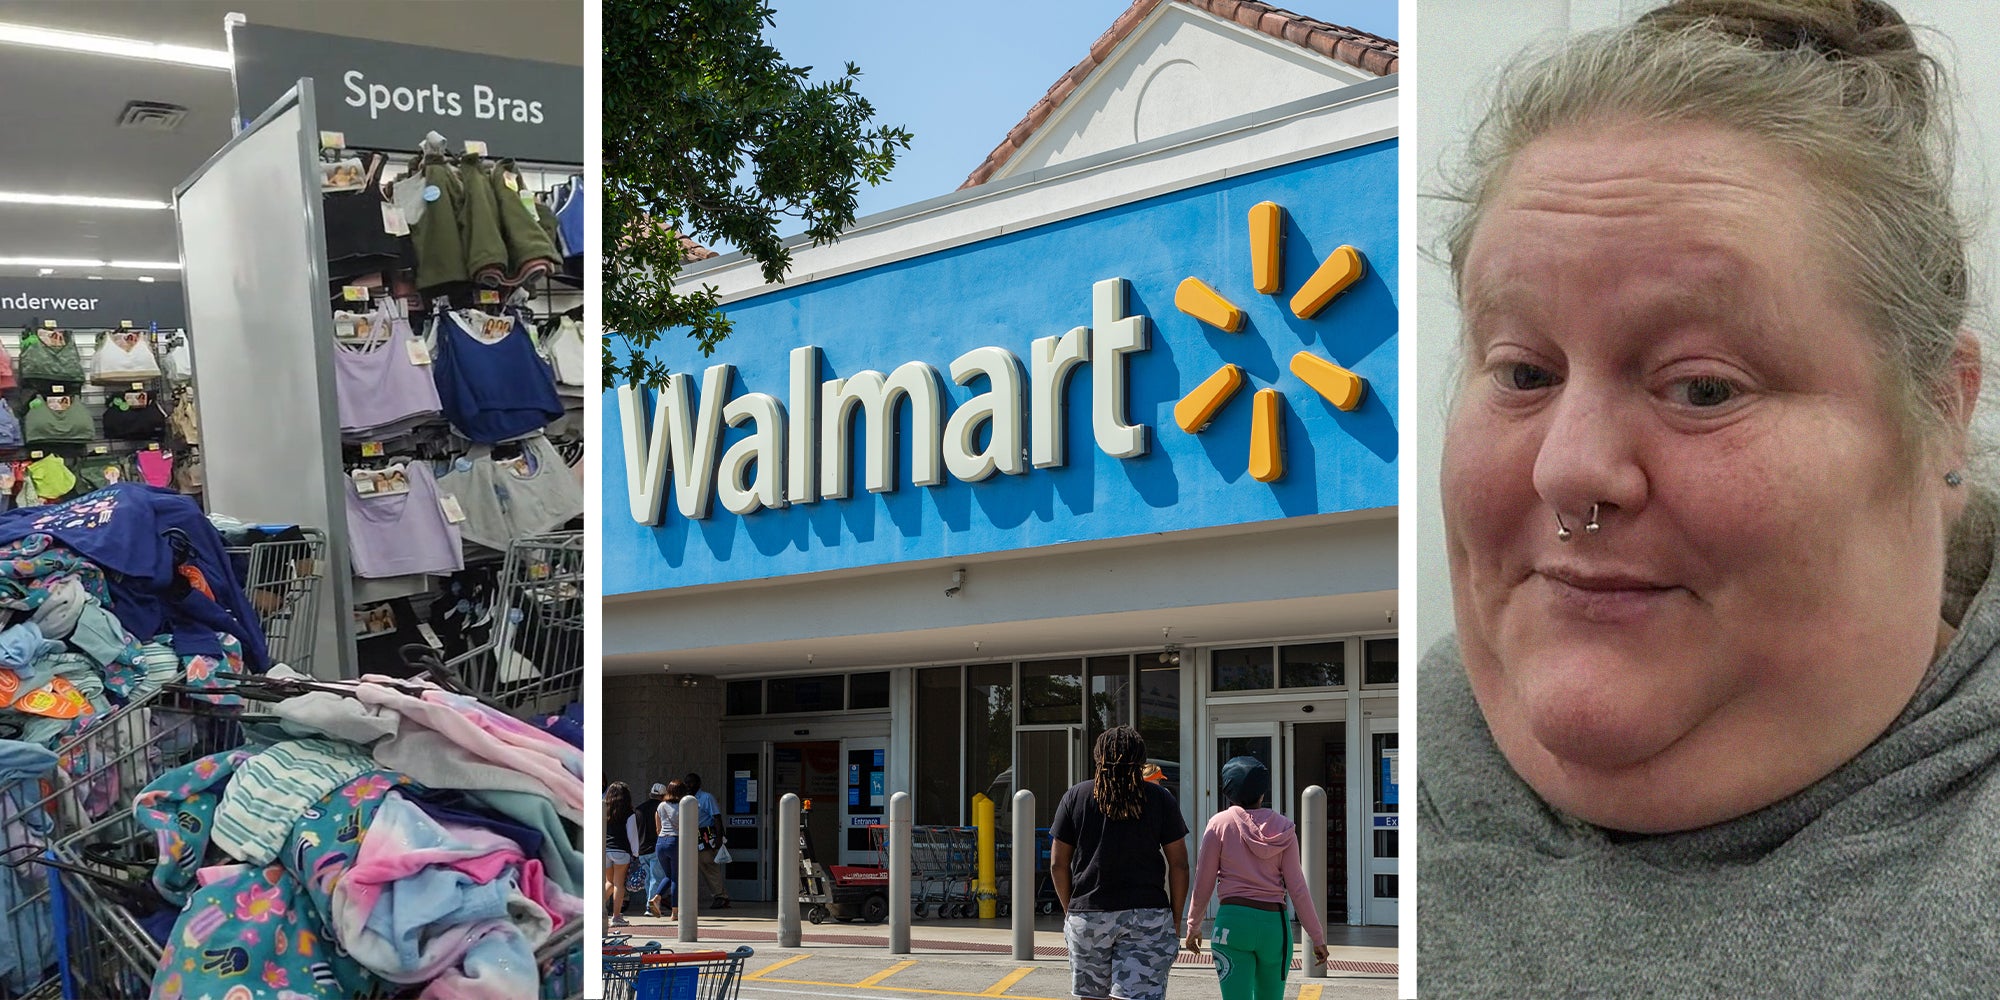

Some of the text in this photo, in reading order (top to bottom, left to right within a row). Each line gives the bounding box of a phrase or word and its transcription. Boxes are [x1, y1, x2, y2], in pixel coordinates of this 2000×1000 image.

[343, 69, 545, 125] Sports Bras
[1, 292, 99, 311] nderwear
[617, 276, 1151, 527] Walmart
[731, 817, 754, 826] Entrance
[854, 817, 879, 826] Entrance
